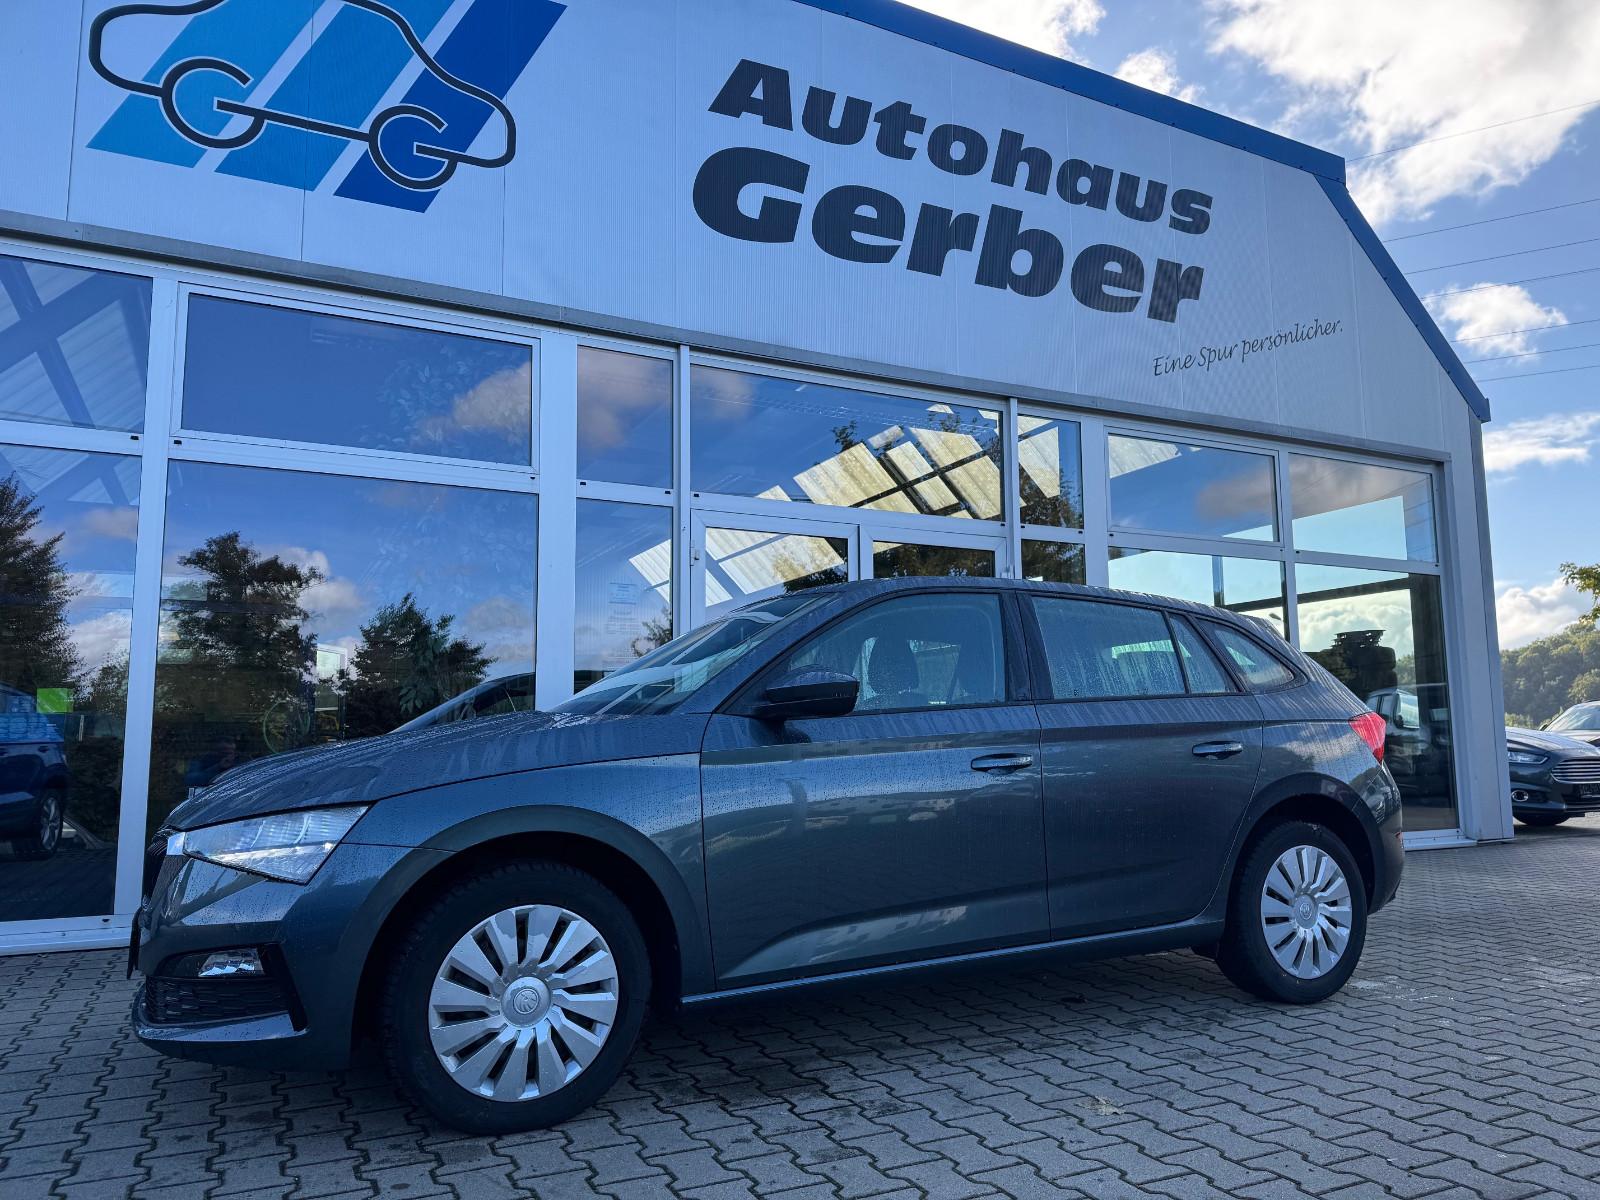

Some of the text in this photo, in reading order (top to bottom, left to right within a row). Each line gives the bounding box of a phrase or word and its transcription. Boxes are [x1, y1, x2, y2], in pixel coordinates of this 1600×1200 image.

[693, 147, 1205, 323] Gerber
[708, 59, 1213, 235] Autohaus
[1153, 318, 1343, 376] Eine Spur persönlicher.
